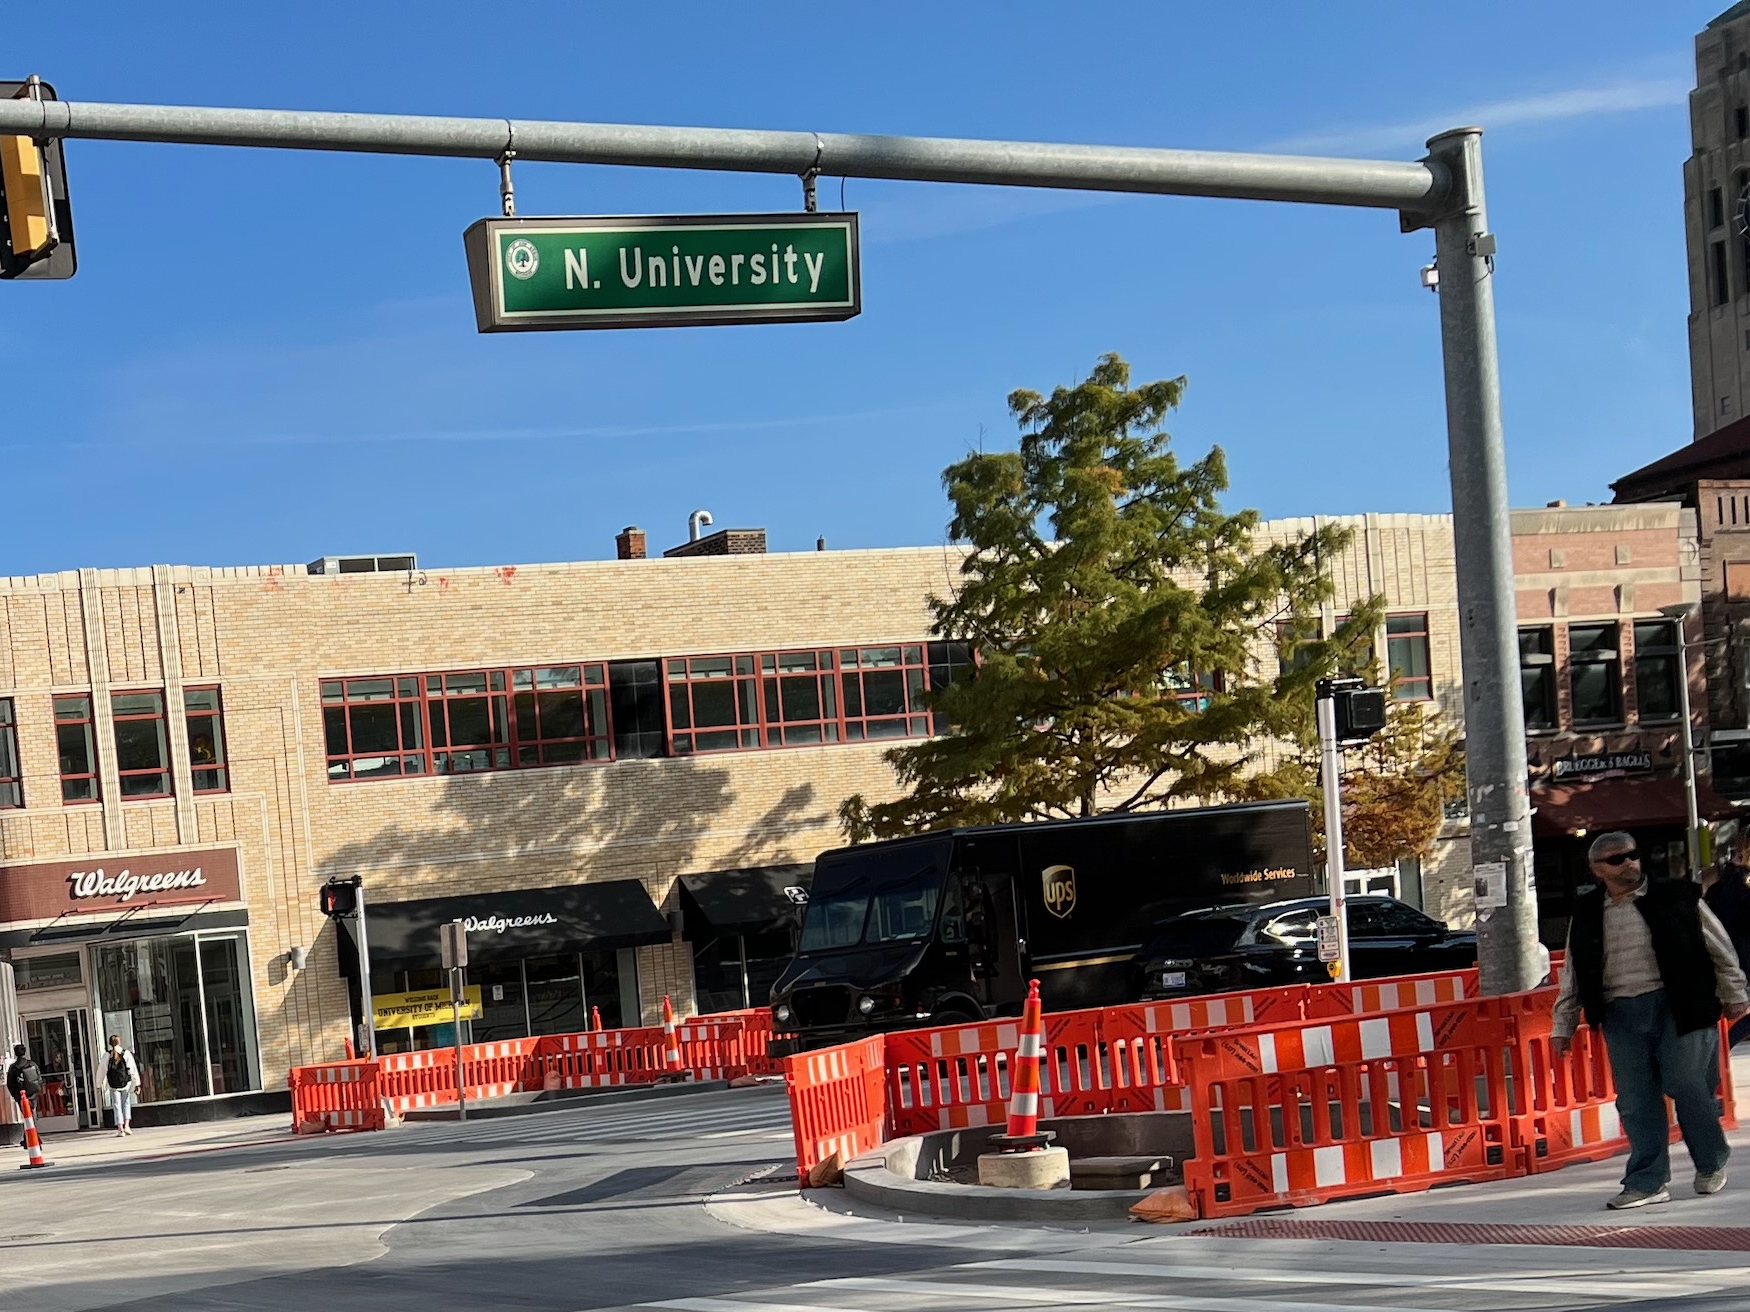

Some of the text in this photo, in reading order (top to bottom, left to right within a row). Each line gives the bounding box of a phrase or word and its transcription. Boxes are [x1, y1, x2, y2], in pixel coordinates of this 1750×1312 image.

[563, 247, 602, 290] N.
[619, 243, 825, 294] University
[70, 867, 207, 901] Walgreens
[1220, 867, 1296, 884] Worldwide Services
[1046, 880, 1074, 910] ups
[453, 912, 557, 934] Walgreens
[378, 1003, 422, 1017] UNIVERSITY
[424, 1003, 432, 1012] OF
